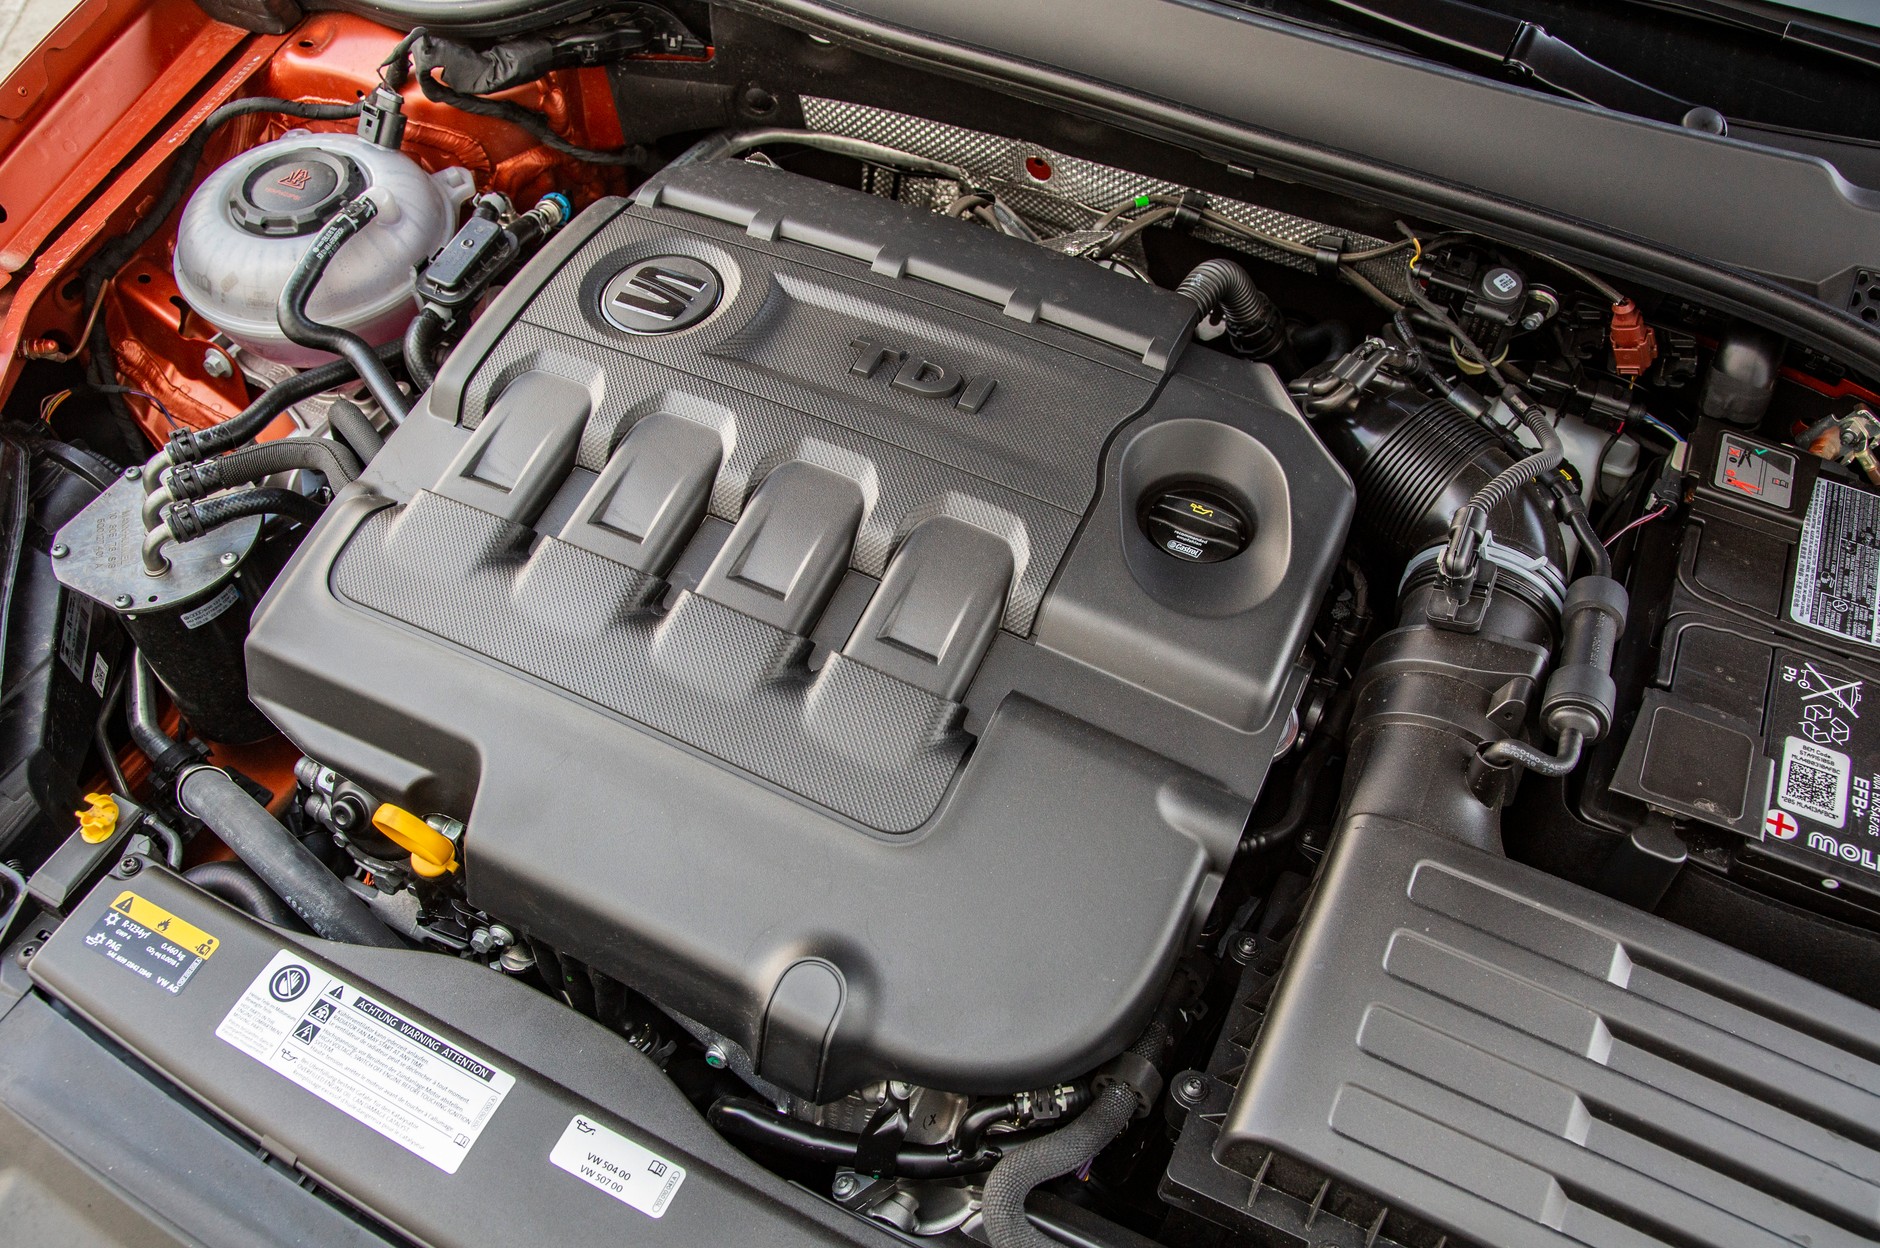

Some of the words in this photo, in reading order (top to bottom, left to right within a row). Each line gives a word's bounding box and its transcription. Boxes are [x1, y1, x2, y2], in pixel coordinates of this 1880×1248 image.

[849, 336, 999, 414] TDI
[1175, 544, 1198, 556] Castrol
[1783, 665, 1797, 682] Pb
[1852, 775, 1871, 817] EFB+
[1807, 831, 1880, 872] MOL
[105, 939, 122, 951] PAG
[122, 920, 151, 938] R-1234yf
[161, 943, 179, 955] 0.460
[177, 951, 186, 961] kg
[157, 976, 169, 987] VW
[167, 984, 179, 993] AG
[332, 1014, 358, 1031] RADIATOR
[356, 1028, 368, 1037] FAN
[366, 1034, 378, 1042] MAY
[377, 1040, 393, 1052] START
[392, 1048, 400, 1056] AT
[399, 1052, 410, 1062] ANY
[357, 1000, 399, 1027] ACHTUNG
[400, 1023, 440, 1051] WARNING
[441, 1048, 489, 1078] ATTENTION
[318, 1034, 332, 1044] HIGH
[353, 1054, 374, 1068] SWITCH
[420, 1092, 448, 1111] TOUCHING
[446, 1108, 472, 1124] IGNITION
[386, 1054, 400, 1064] peut
[436, 1082, 448, 1092] tout
[424, 1086, 440, 1099] Motor
[581, 1165, 595, 1177] VW
[595, 1173, 611, 1185] 507
[611, 1182, 623, 1192] 00
[588, 1153, 602, 1165] VW
[602, 1161, 618, 1174] 504
[619, 1170, 631, 1180] 00
